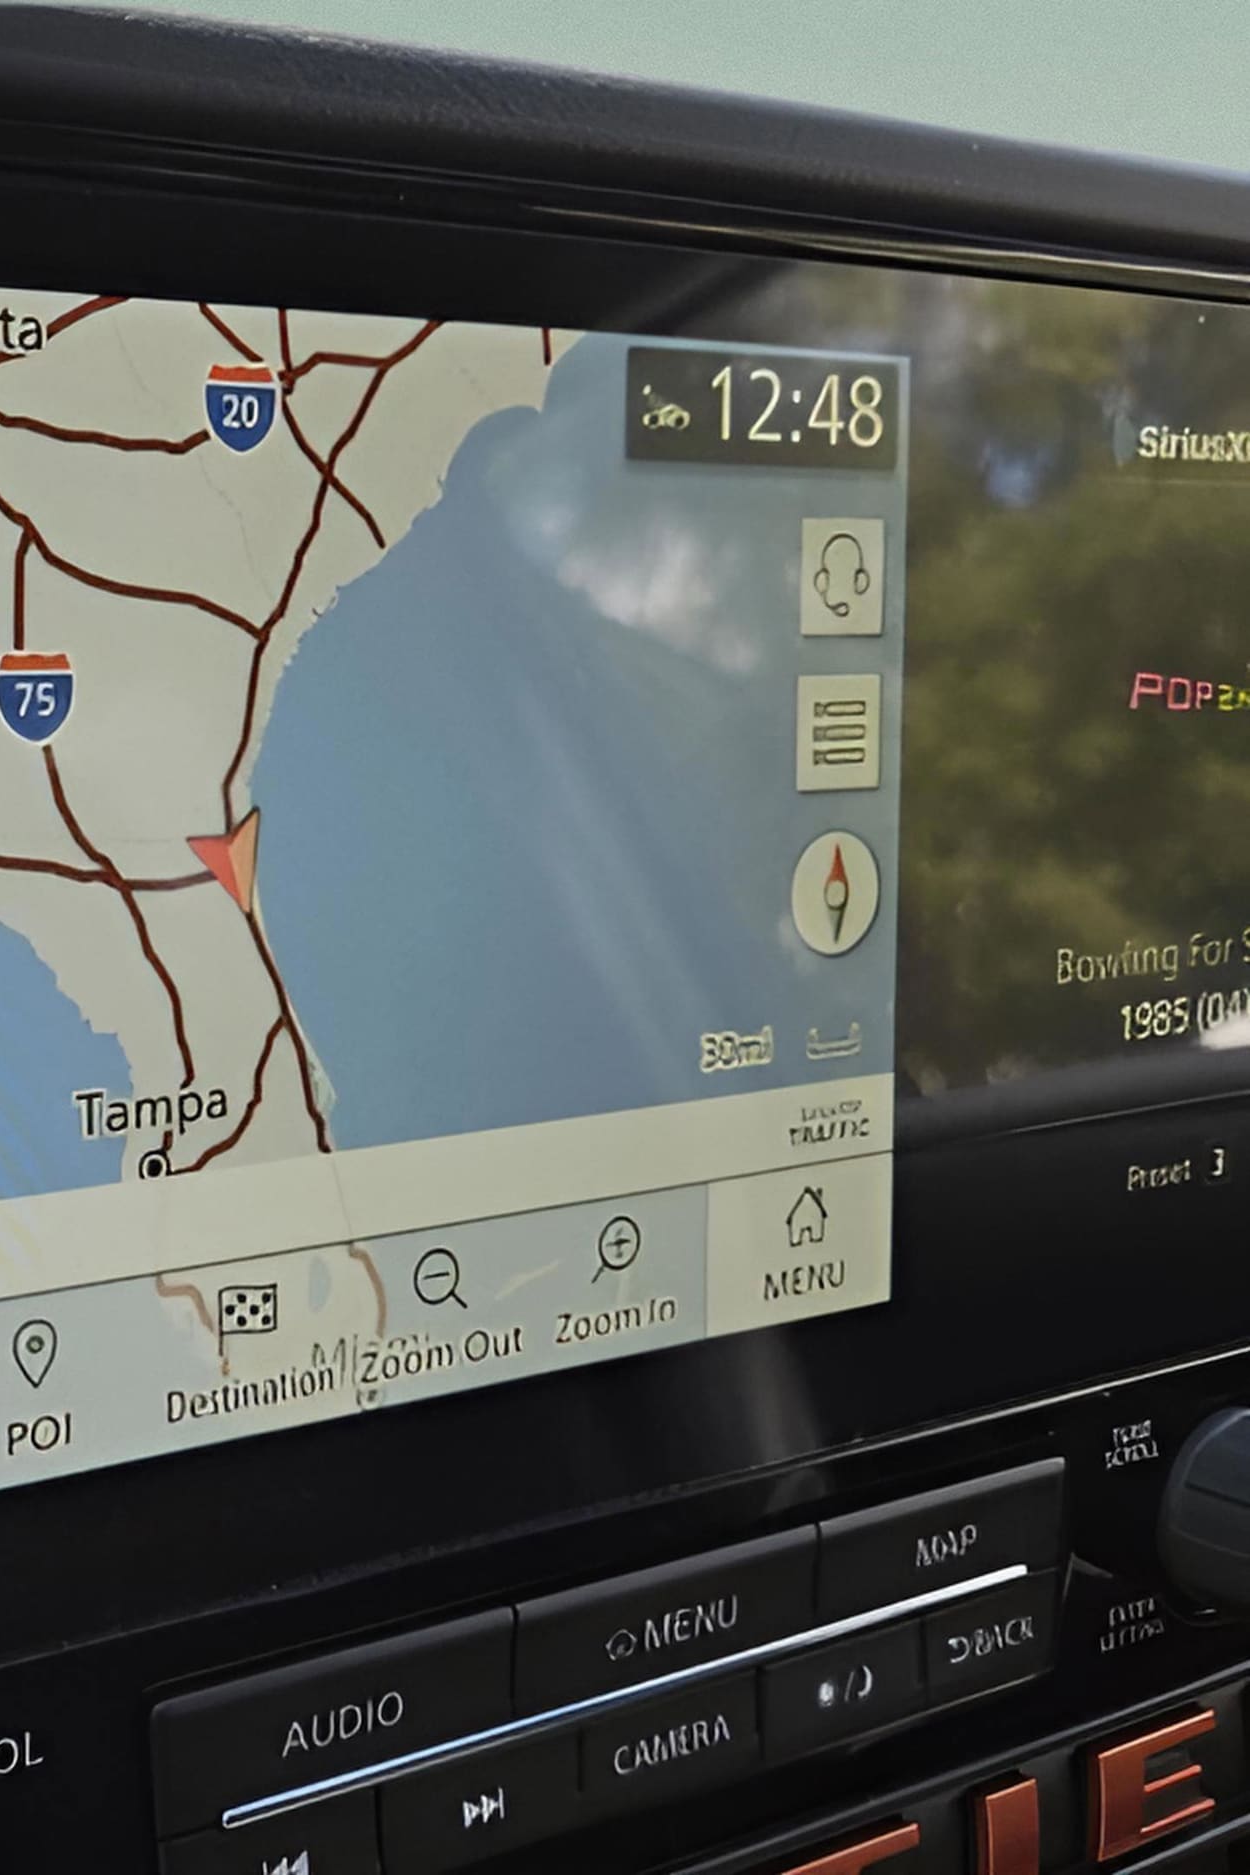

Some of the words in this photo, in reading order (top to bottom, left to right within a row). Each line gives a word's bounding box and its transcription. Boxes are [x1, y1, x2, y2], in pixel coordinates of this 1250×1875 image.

[222, 392, 260, 430] 20
[711, 365, 884, 447] 12:48
[14, 681, 56, 721] 75
[1121, 997, 1189, 1040] 1985
[76, 1083, 229, 1138] Tampa
[762, 1260, 845, 1301] MENU
[555, 1304, 641, 1344] Zoom
[647, 1297, 676, 1325] In
[360, 1342, 453, 1384] Zoom
[463, 1326, 523, 1362] Out
[166, 1366, 335, 1423] Destination
[6, 1413, 72, 1456] POI
[915, 1523, 978, 1567] MAP
[645, 1594, 739, 1652] MENU
[282, 1690, 404, 1758] AUDIO
[613, 1713, 731, 1775] CAMERA
